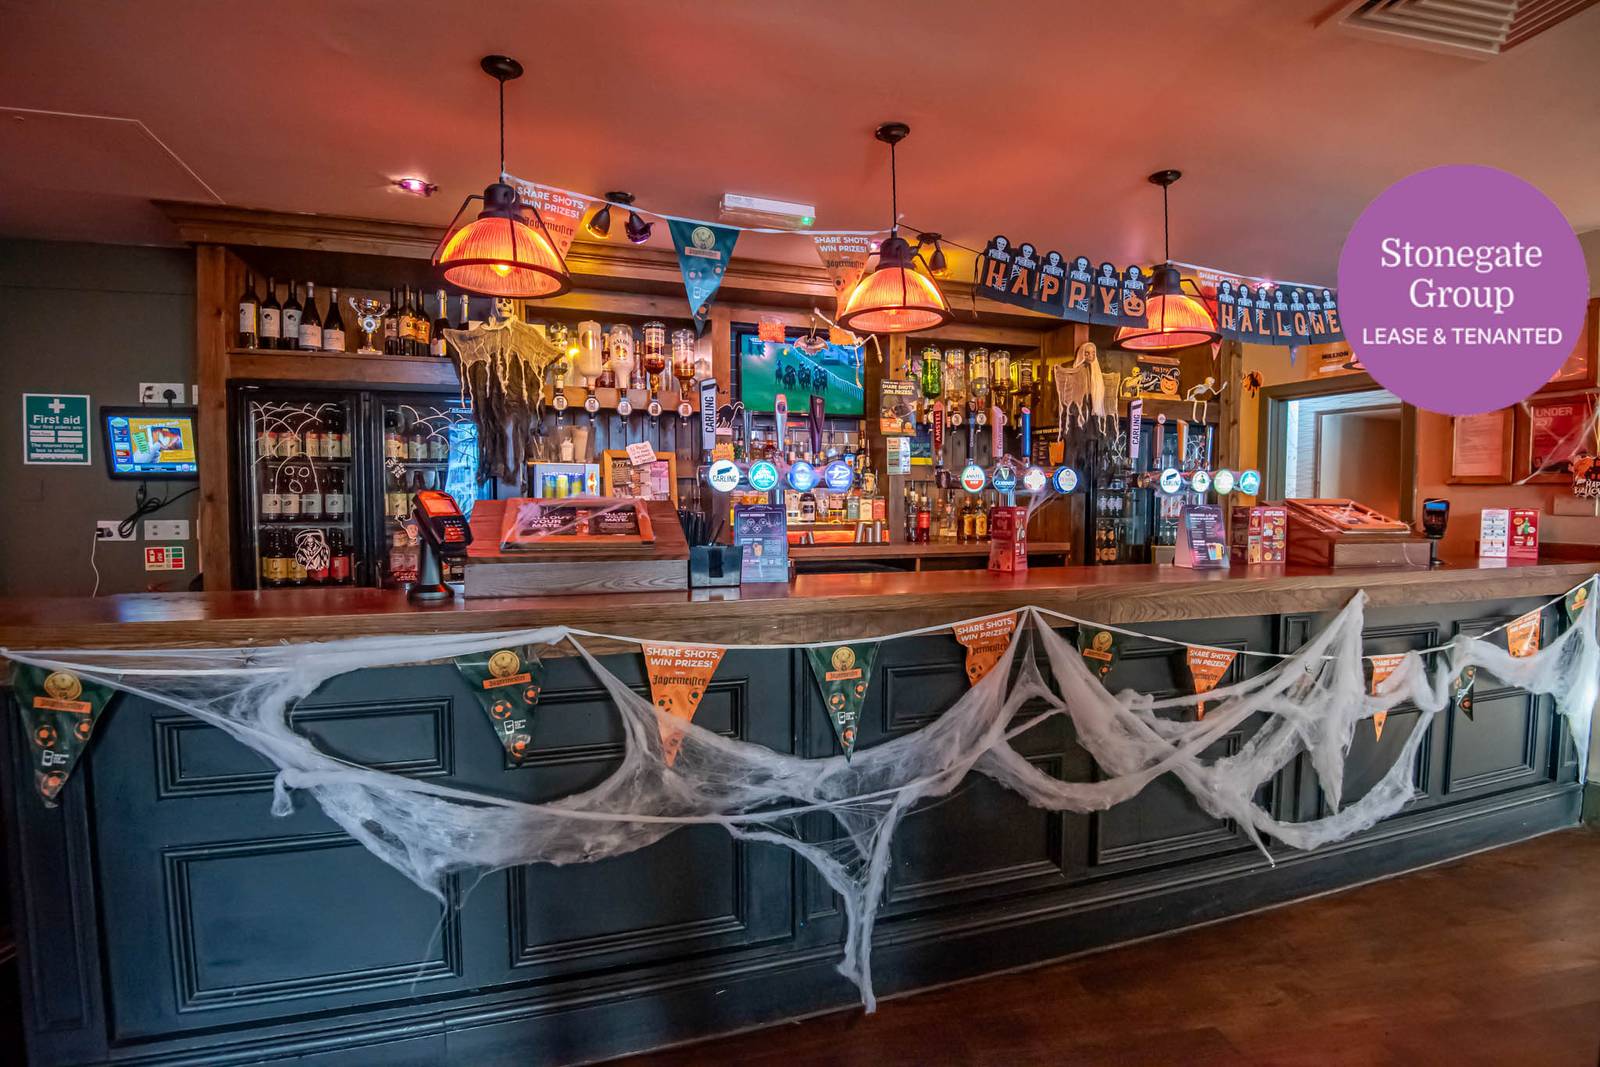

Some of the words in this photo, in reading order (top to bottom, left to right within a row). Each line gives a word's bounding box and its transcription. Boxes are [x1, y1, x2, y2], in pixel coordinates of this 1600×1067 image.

[517, 186, 550, 201] SHARE
[522, 198, 541, 210] WIN
[544, 202, 580, 219] PRIZES!
[814, 236, 842, 244] SHARE
[820, 245, 837, 253] WIN
[986, 259, 1116, 315] HAPPY
[1221, 303, 1342, 337] HALLOWE
[704, 396, 714, 433] CARLING
[1535, 407, 1573, 417] UNDER
[33, 414, 60, 424] First
[63, 416, 81, 425] aid
[1132, 414, 1141, 446] CARLING
[712, 474, 737, 483] CARLING
[957, 623, 984, 635] SHARE
[960, 634, 978, 642] WIN
[646, 647, 681, 657] SHARE
[684, 649, 720, 660] SHOTS,
[1189, 649, 1210, 658] SHARE
[650, 658, 672, 667] WIN
[675, 660, 713, 669] PRIZES!
